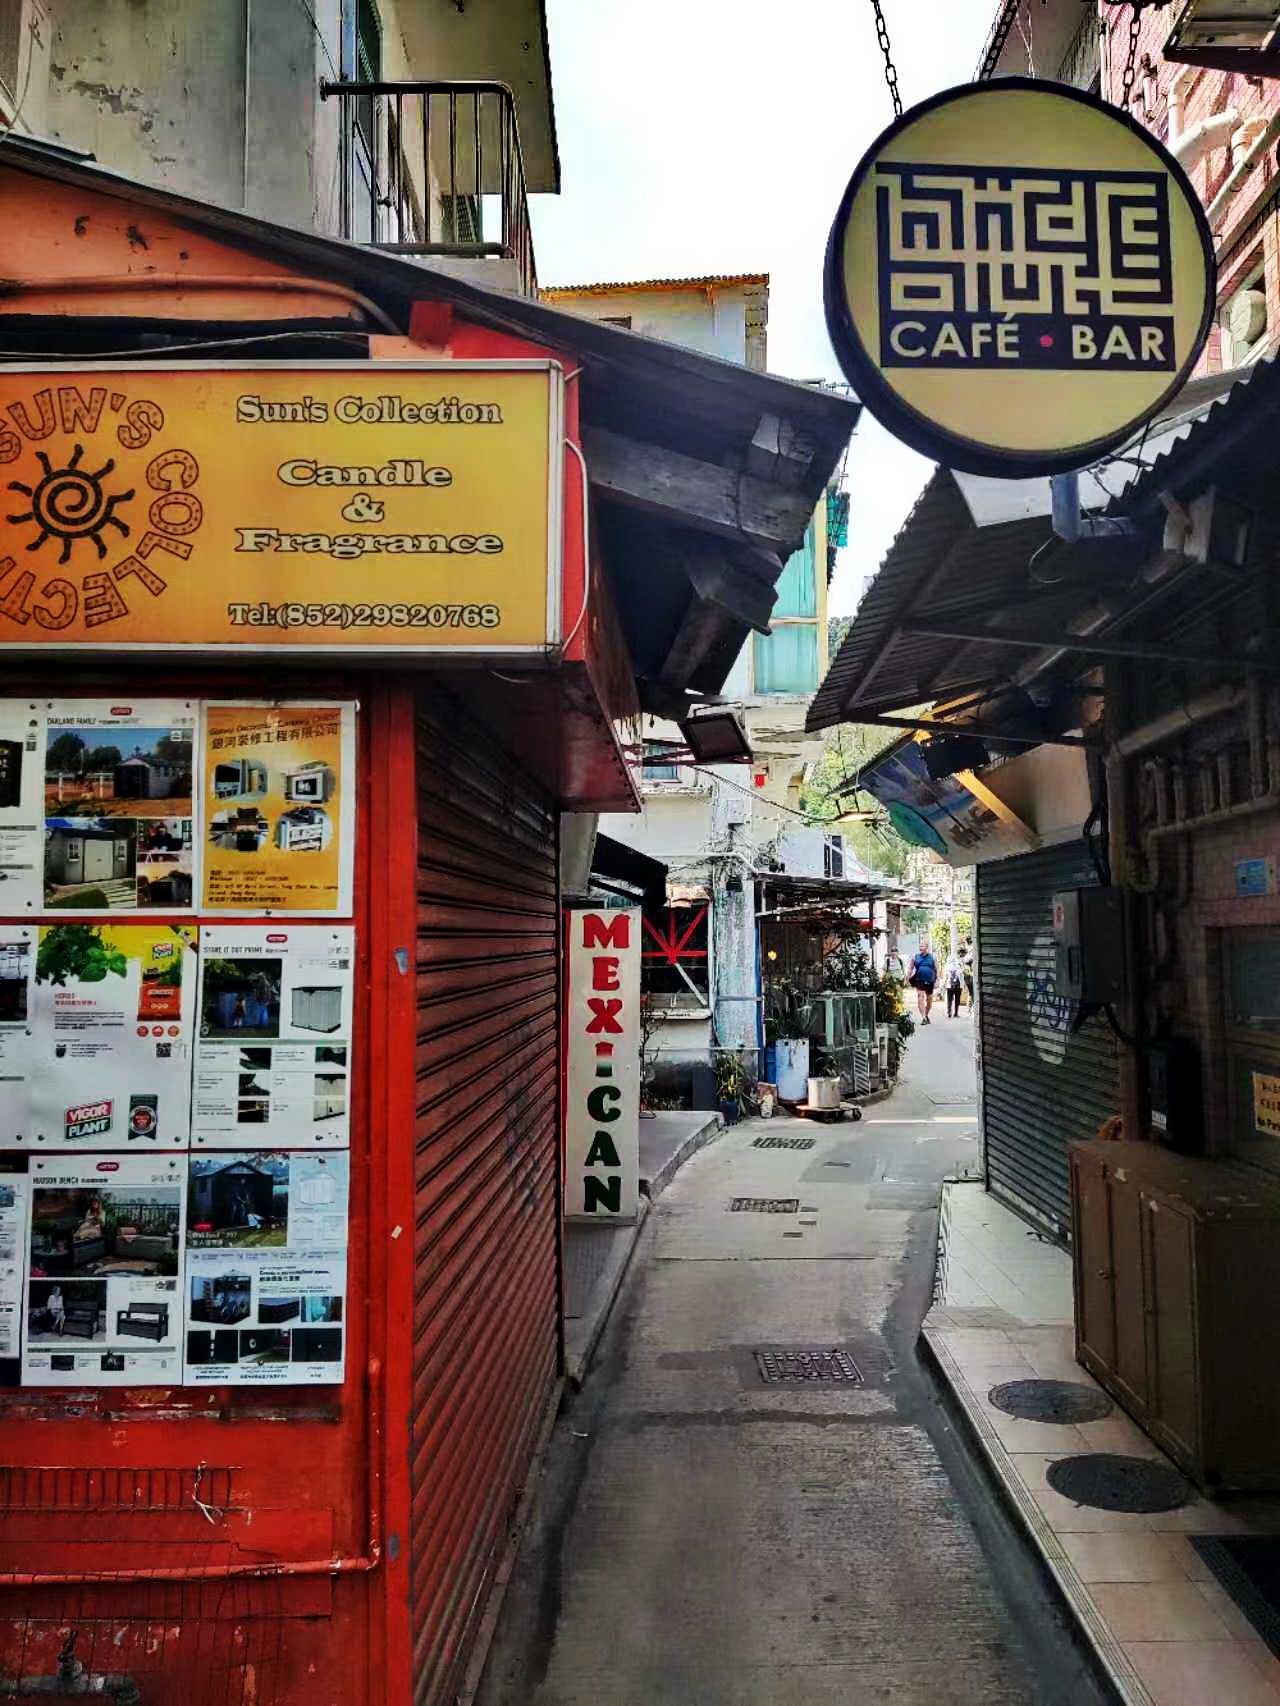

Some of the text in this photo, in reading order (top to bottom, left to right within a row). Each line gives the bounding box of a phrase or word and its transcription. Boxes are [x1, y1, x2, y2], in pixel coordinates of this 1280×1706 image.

[890, 313, 1167, 362] CAFÉ BAR
[237, 395, 503, 424] Sun's Collection
[277, 459, 453, 488] Candle
[342, 493, 385, 523] &
[234, 528, 503, 559] Fragrance
[228, 602, 500, 629] Tel:(852)29820768
[69, 1103, 109, 1122] VIGOR
[68, 1119, 108, 1137] PLANT
